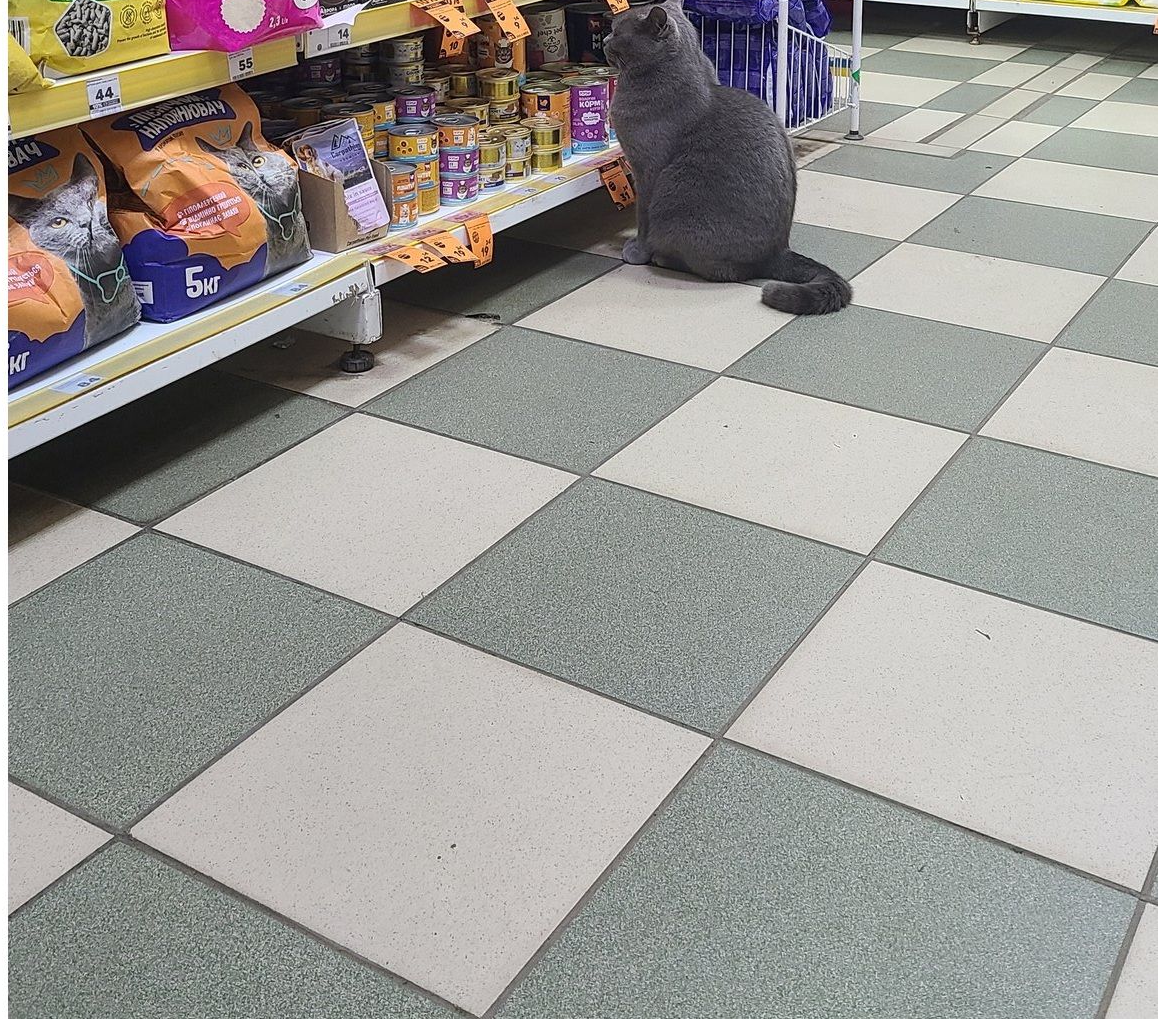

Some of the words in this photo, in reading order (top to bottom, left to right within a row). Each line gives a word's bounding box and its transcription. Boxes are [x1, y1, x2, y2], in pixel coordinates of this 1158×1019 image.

[514, 21, 520, 29] 9
[337, 28, 349, 39] 14
[238, 57, 253, 71] 55
[95, 85, 114, 101] 44
[481, 246, 489, 257] 19
[420, 256, 434, 264] 12
